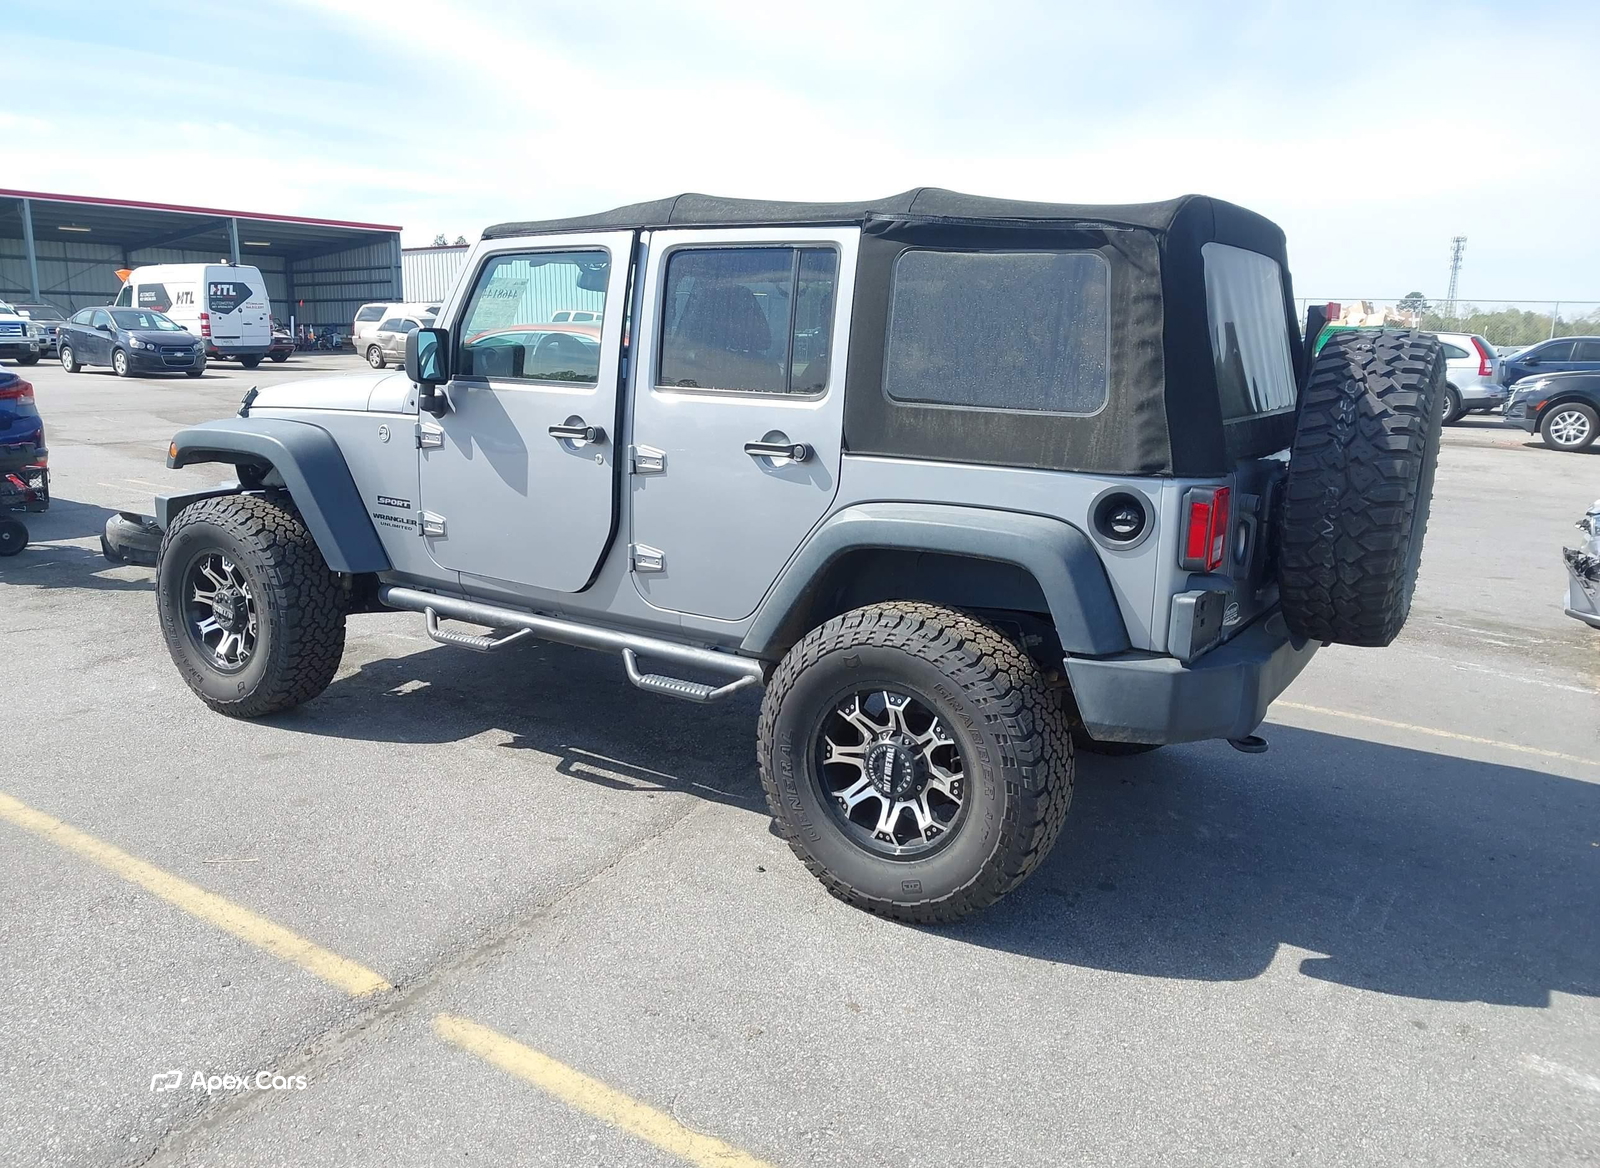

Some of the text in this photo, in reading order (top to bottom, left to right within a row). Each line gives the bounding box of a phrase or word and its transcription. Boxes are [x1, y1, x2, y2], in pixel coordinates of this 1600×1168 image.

[210, 284, 237, 295] HTL
[176, 291, 195, 305] HTL
[379, 497, 409, 508] SPORT
[372, 512, 418, 526] WRANGLER
[380, 521, 413, 530] UNLIMITED
[933, 682, 995, 801] GRABBER
[883, 748, 895, 792] M/T METAL
[780, 728, 821, 843] GENERAL
